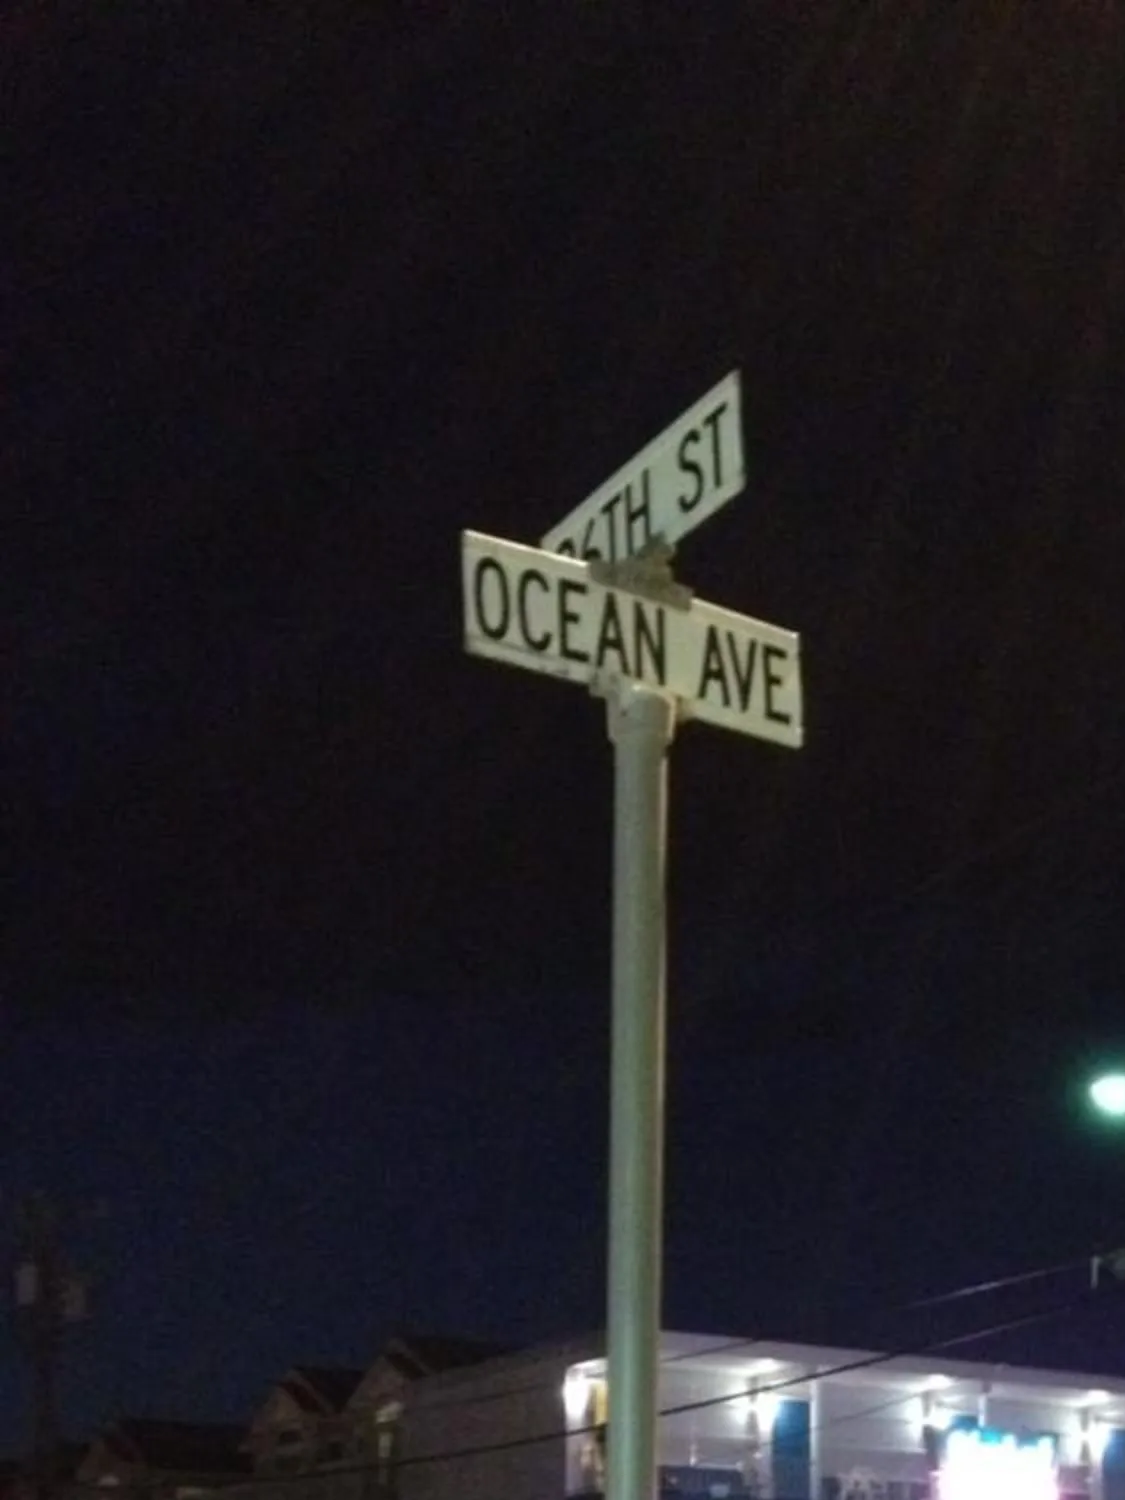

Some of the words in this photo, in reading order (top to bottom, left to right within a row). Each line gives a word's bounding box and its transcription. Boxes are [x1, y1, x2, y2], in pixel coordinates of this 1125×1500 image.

[676, 403, 727, 513] ST
[474, 556, 667, 686] OCEAN
[699, 625, 792, 725] AVE
